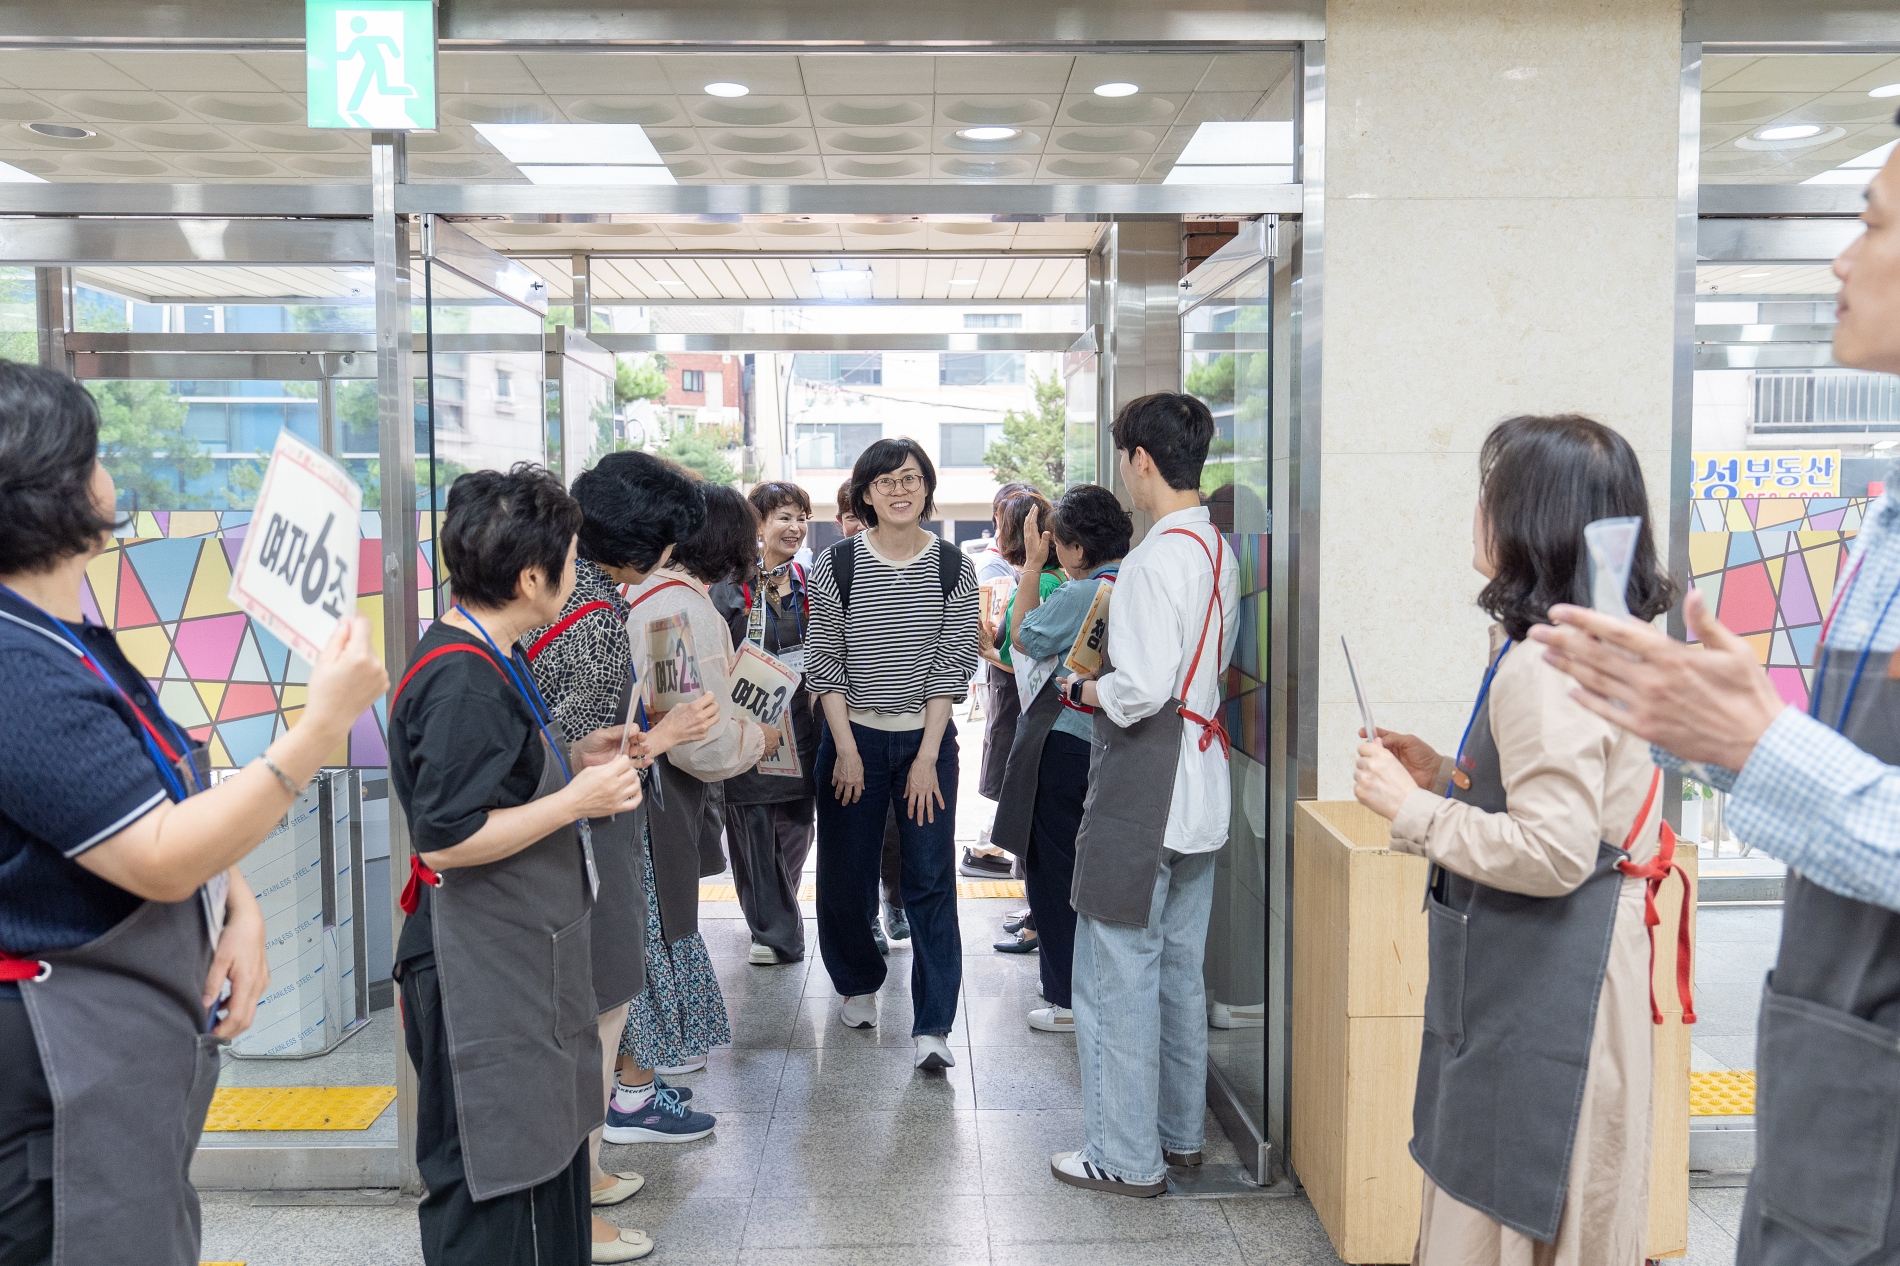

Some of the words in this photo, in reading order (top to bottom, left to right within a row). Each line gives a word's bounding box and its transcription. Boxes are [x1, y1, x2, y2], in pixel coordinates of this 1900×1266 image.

[1690, 459, 1738, 498] 성
[259, 511, 349, 619] 여자6조
[654, 638, 701, 694] 여자2조
[290, 813, 309, 827] STEEL
[262, 877, 292, 897] STAINLESS
[292, 867, 310, 880] STEEL
[265, 930, 294, 950] STAINLESS
[294, 920, 311, 934] STEEL
[265, 983, 296, 1004] STAINLESS
[295, 973, 313, 988] STEEL
[267, 1037, 297, 1055] STAINLESS
[297, 1026, 315, 1041] STEEL
